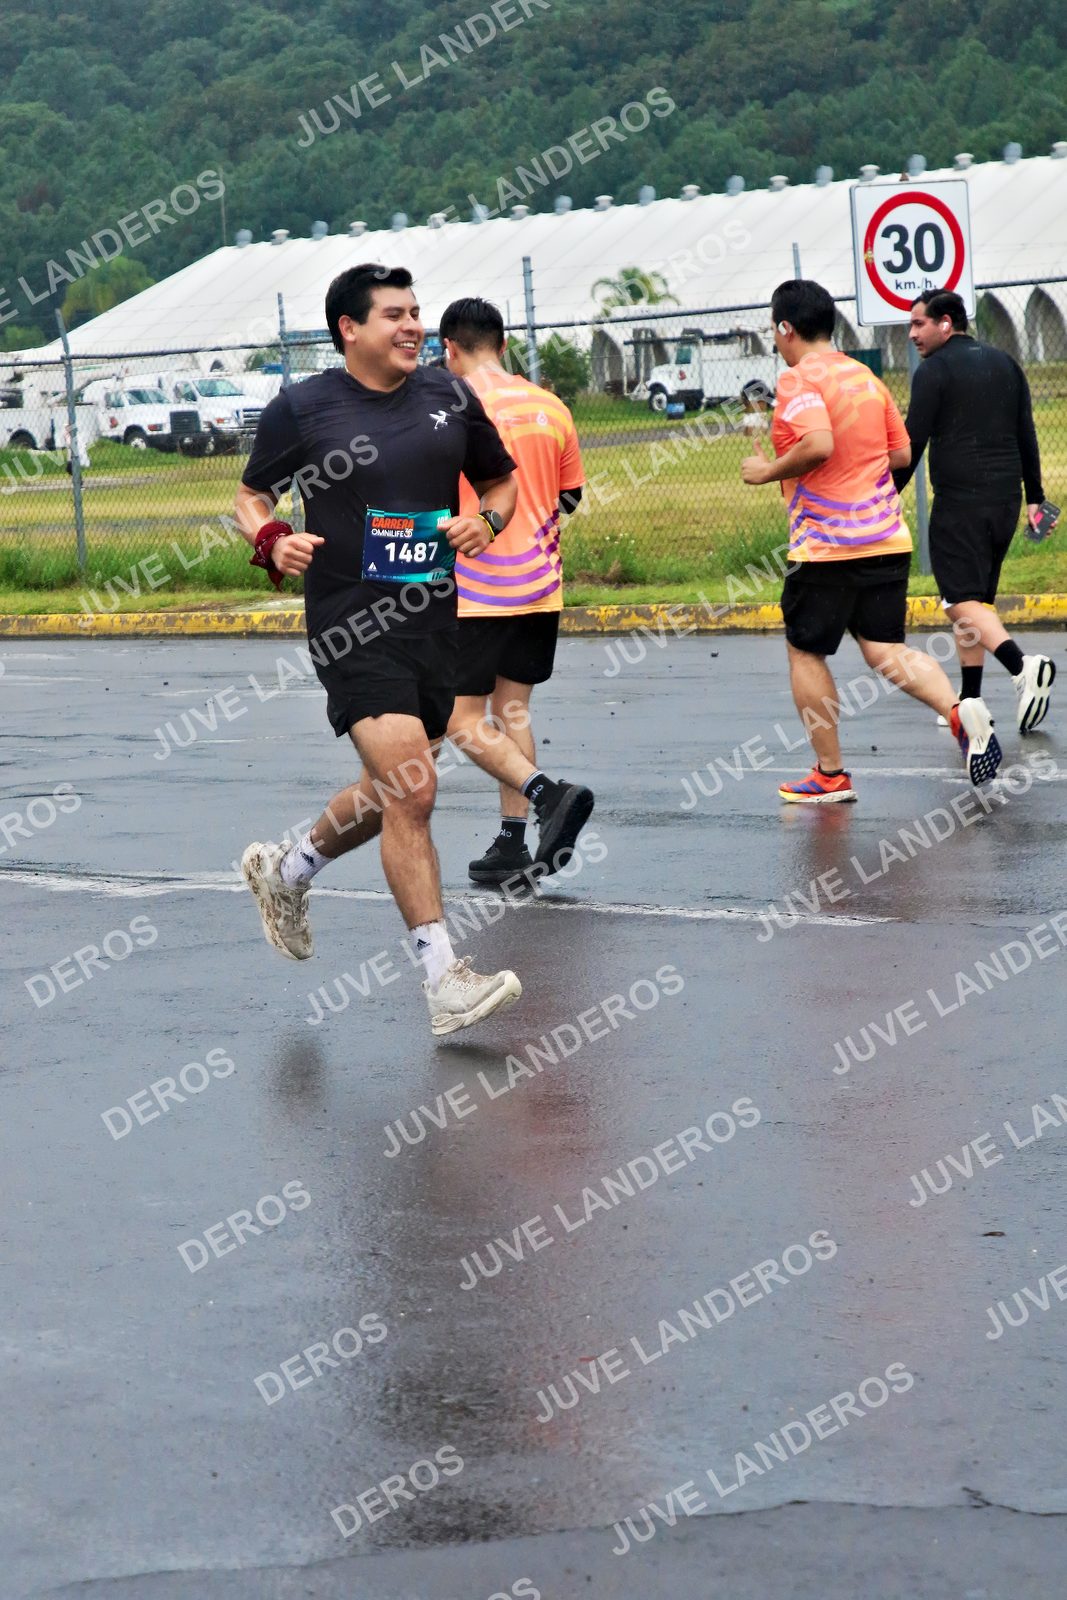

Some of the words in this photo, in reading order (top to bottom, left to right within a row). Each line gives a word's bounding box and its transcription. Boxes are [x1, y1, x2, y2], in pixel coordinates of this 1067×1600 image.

[881, 222, 945, 274] 30
[371, 516, 415, 531] CARRERA
[384, 541, 439, 563] 1487
